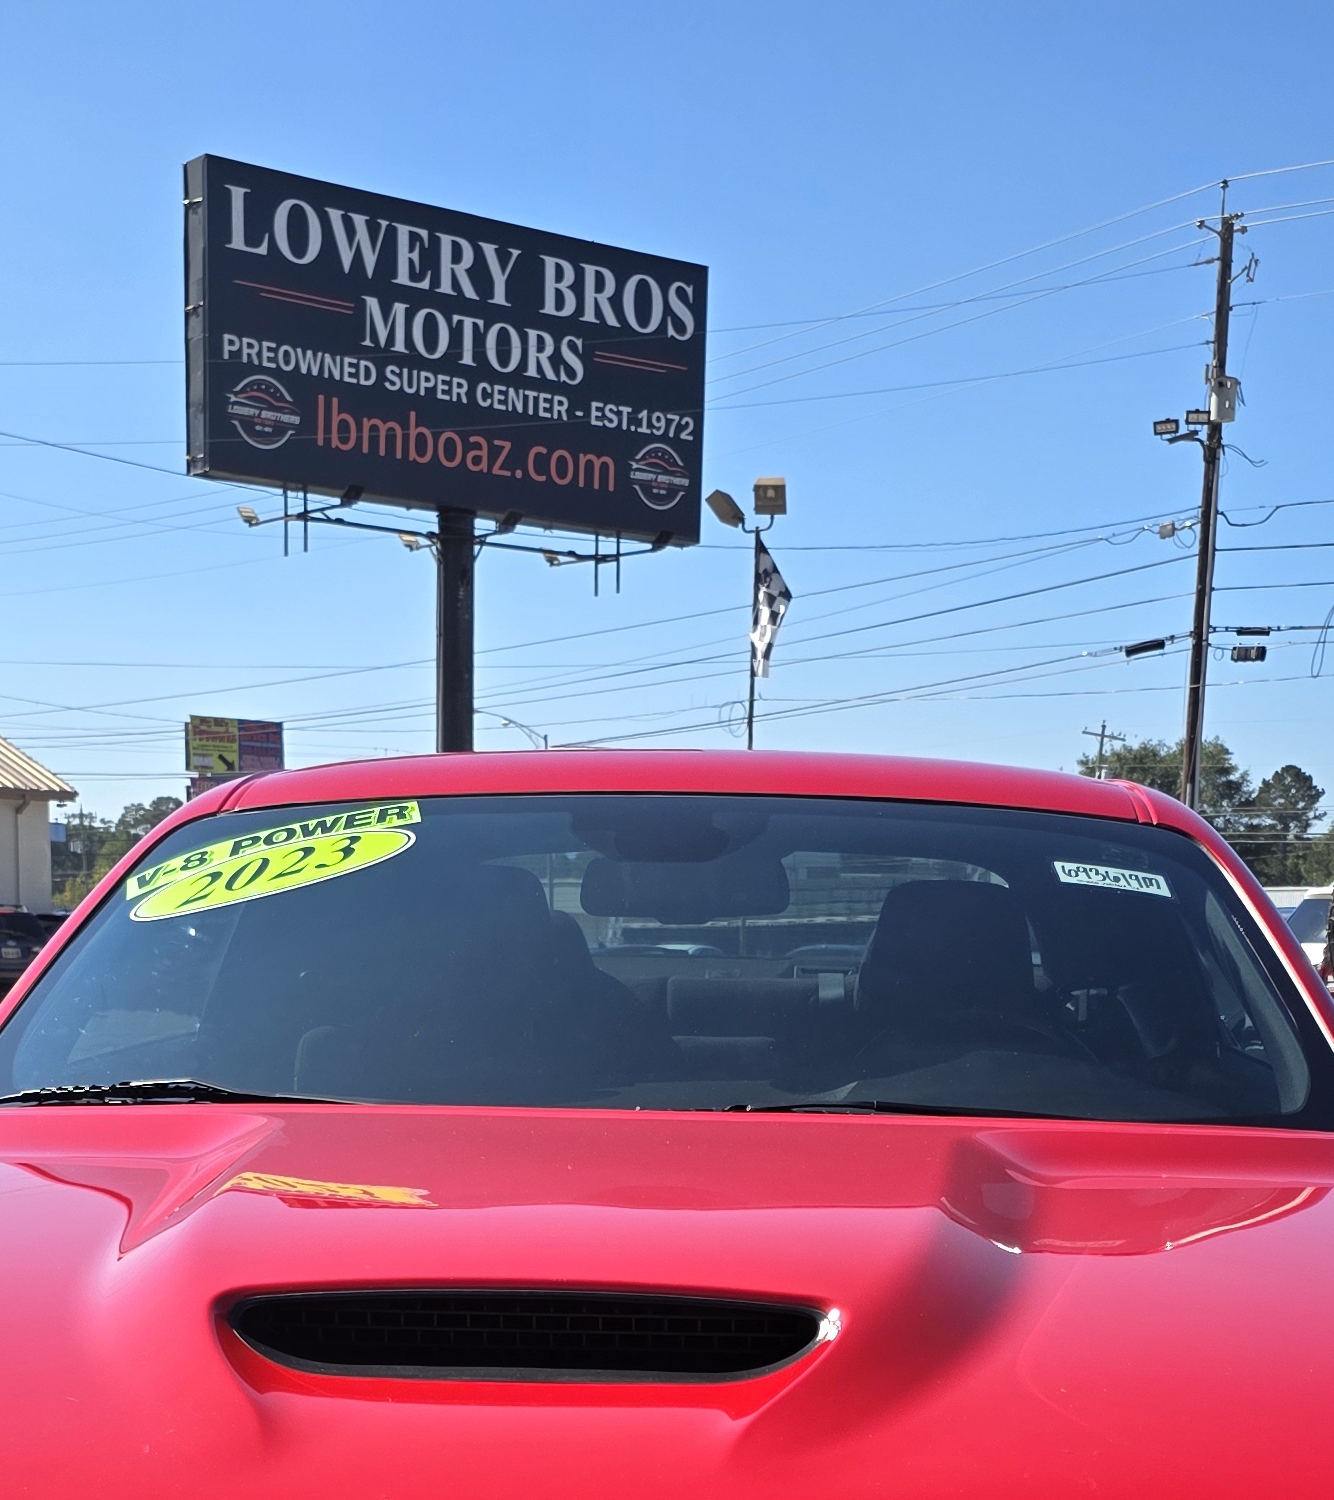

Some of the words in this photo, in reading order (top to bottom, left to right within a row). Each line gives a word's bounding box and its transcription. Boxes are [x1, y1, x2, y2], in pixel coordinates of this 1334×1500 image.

[224, 184, 521, 307] LOWERY
[539, 254, 695, 341] BROS
[223, 333, 377, 387] PREOWNED
[384, 364, 468, 404] SUPER
[476, 382, 569, 421] CENTER
[591, 401, 694, 441] EST.1972
[361, 295, 584, 385] MOTORS
[317, 394, 615, 492] lbmboaz.com
[136, 850, 213, 890] V-8
[229, 804, 415, 857] POWER
[175, 835, 362, 909] 2023
